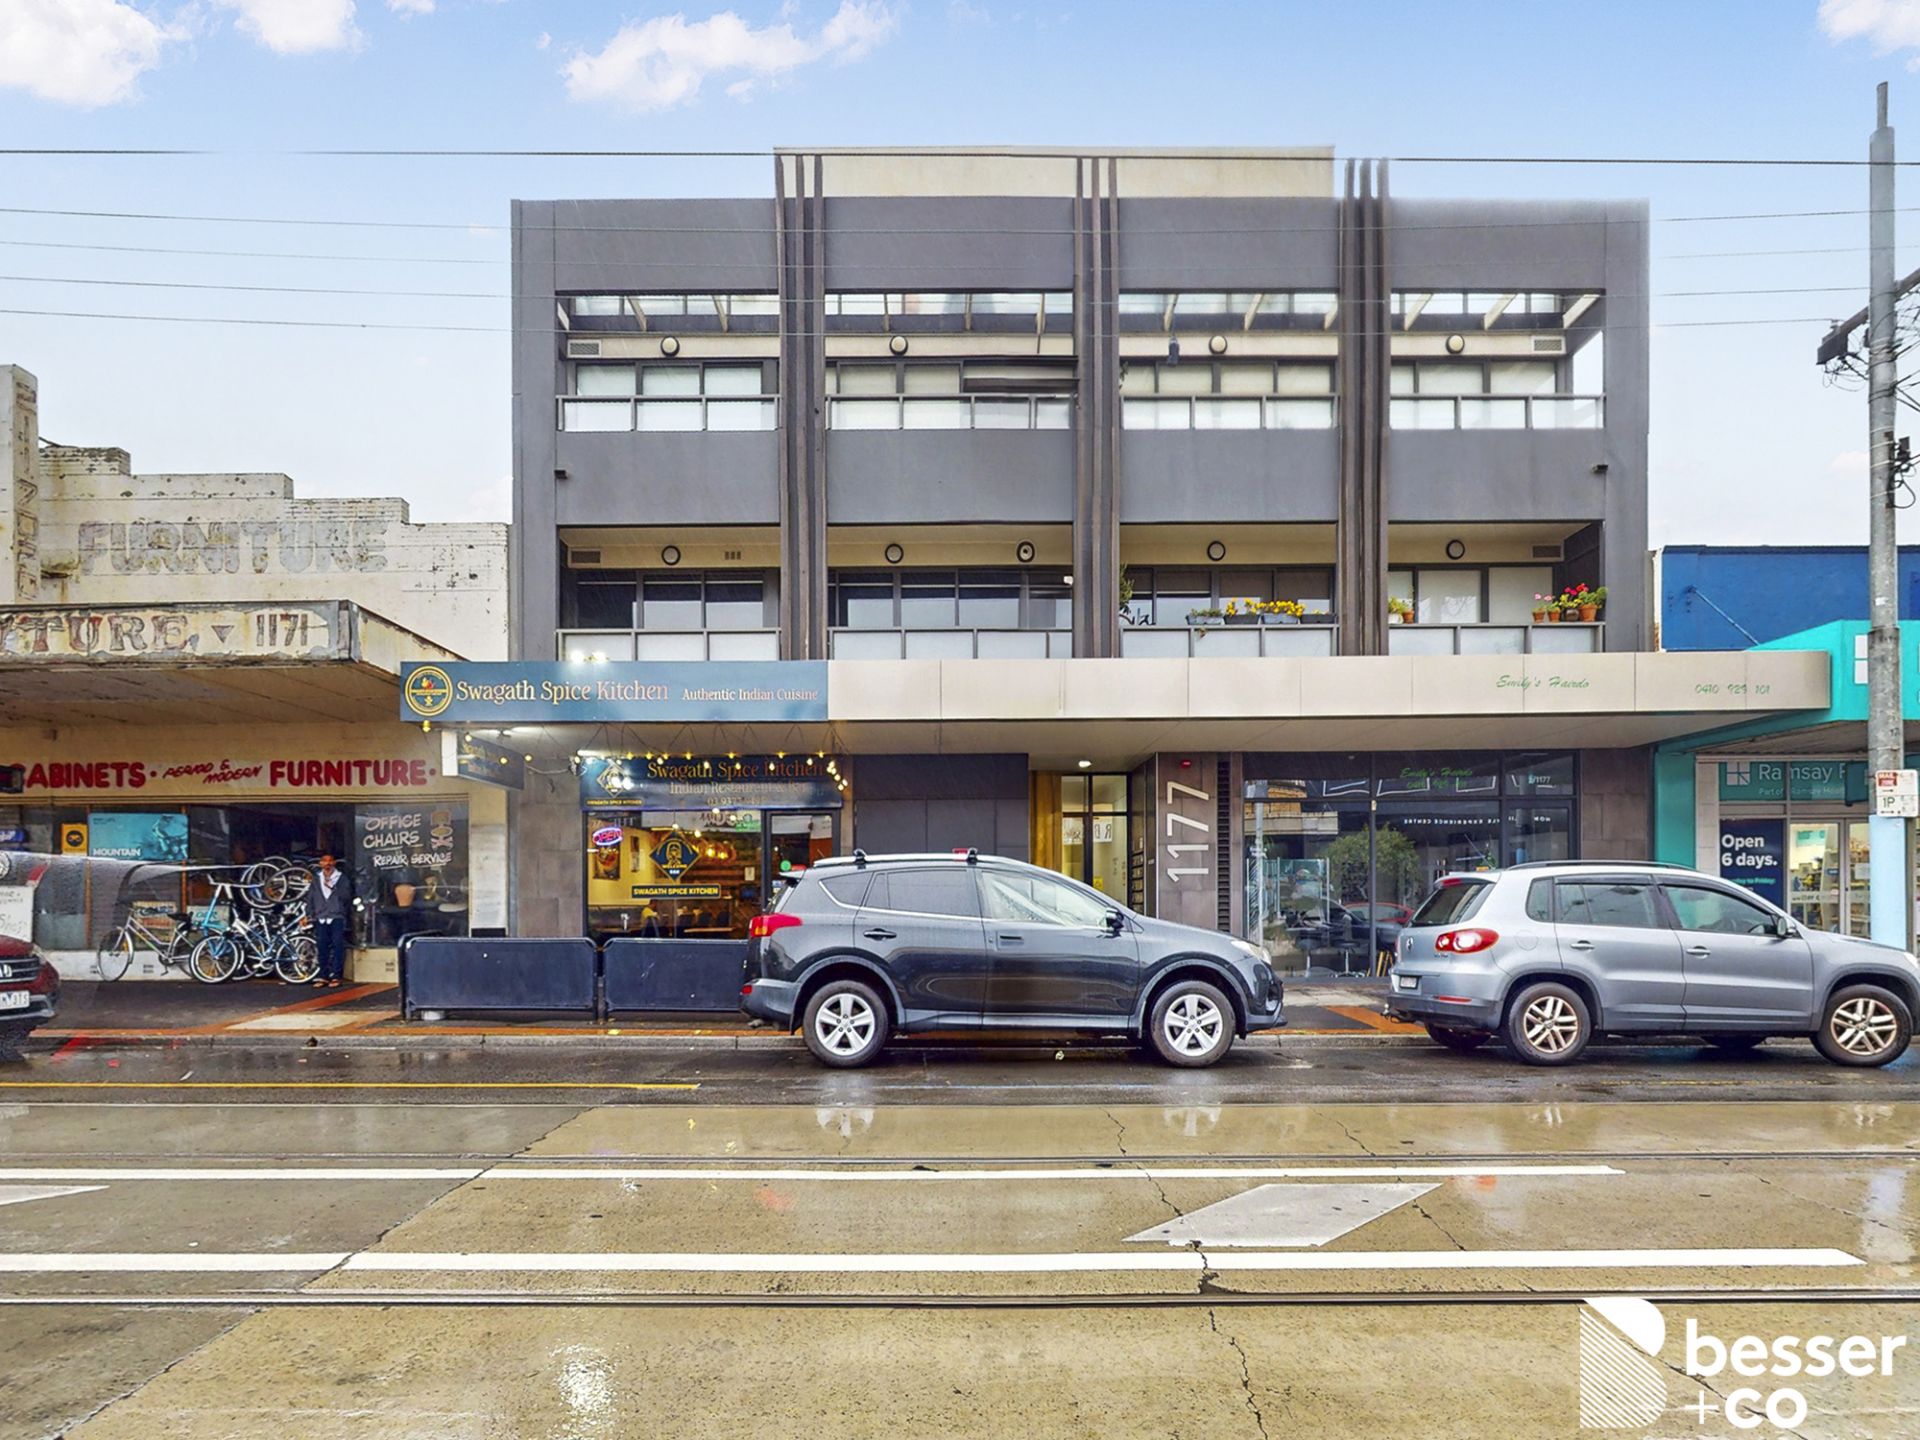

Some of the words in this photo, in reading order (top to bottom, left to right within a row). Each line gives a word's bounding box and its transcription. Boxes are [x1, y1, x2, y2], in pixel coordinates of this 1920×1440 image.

[78, 521, 389, 574] FURNITURE
[256, 613, 308, 646] 1171
[456, 680, 536, 705] Swagath
[541, 680, 590, 705] Spice
[596, 680, 669, 701] Kitchen
[682, 687, 735, 701] Authentic
[738, 688, 774, 701] Indian
[776, 688, 818, 701] Cuisine
[220, 759, 230, 770] &
[269, 759, 428, 786] FURNITURE
[648, 761, 713, 781] Swagath
[717, 761, 759, 782] Spice
[1760, 763, 1832, 784] Ramsay
[203, 765, 262, 784] MODERN
[670, 781, 708, 794] Indian
[365, 813, 421, 831] OFFICE
[363, 831, 420, 848] CHAIRS
[1167, 781, 1209, 882] 1177
[1721, 834, 1765, 851] Open
[93, 847, 141, 857] MOUNTAIN
[411, 852, 452, 864] SERVICE
[1721, 853, 1733, 866] 6
[1736, 852, 1778, 869] days.
[633, 887, 667, 896] SWAGATH
[668, 887, 688, 896] SPICE
[689, 887, 719, 896] KITCHEN
